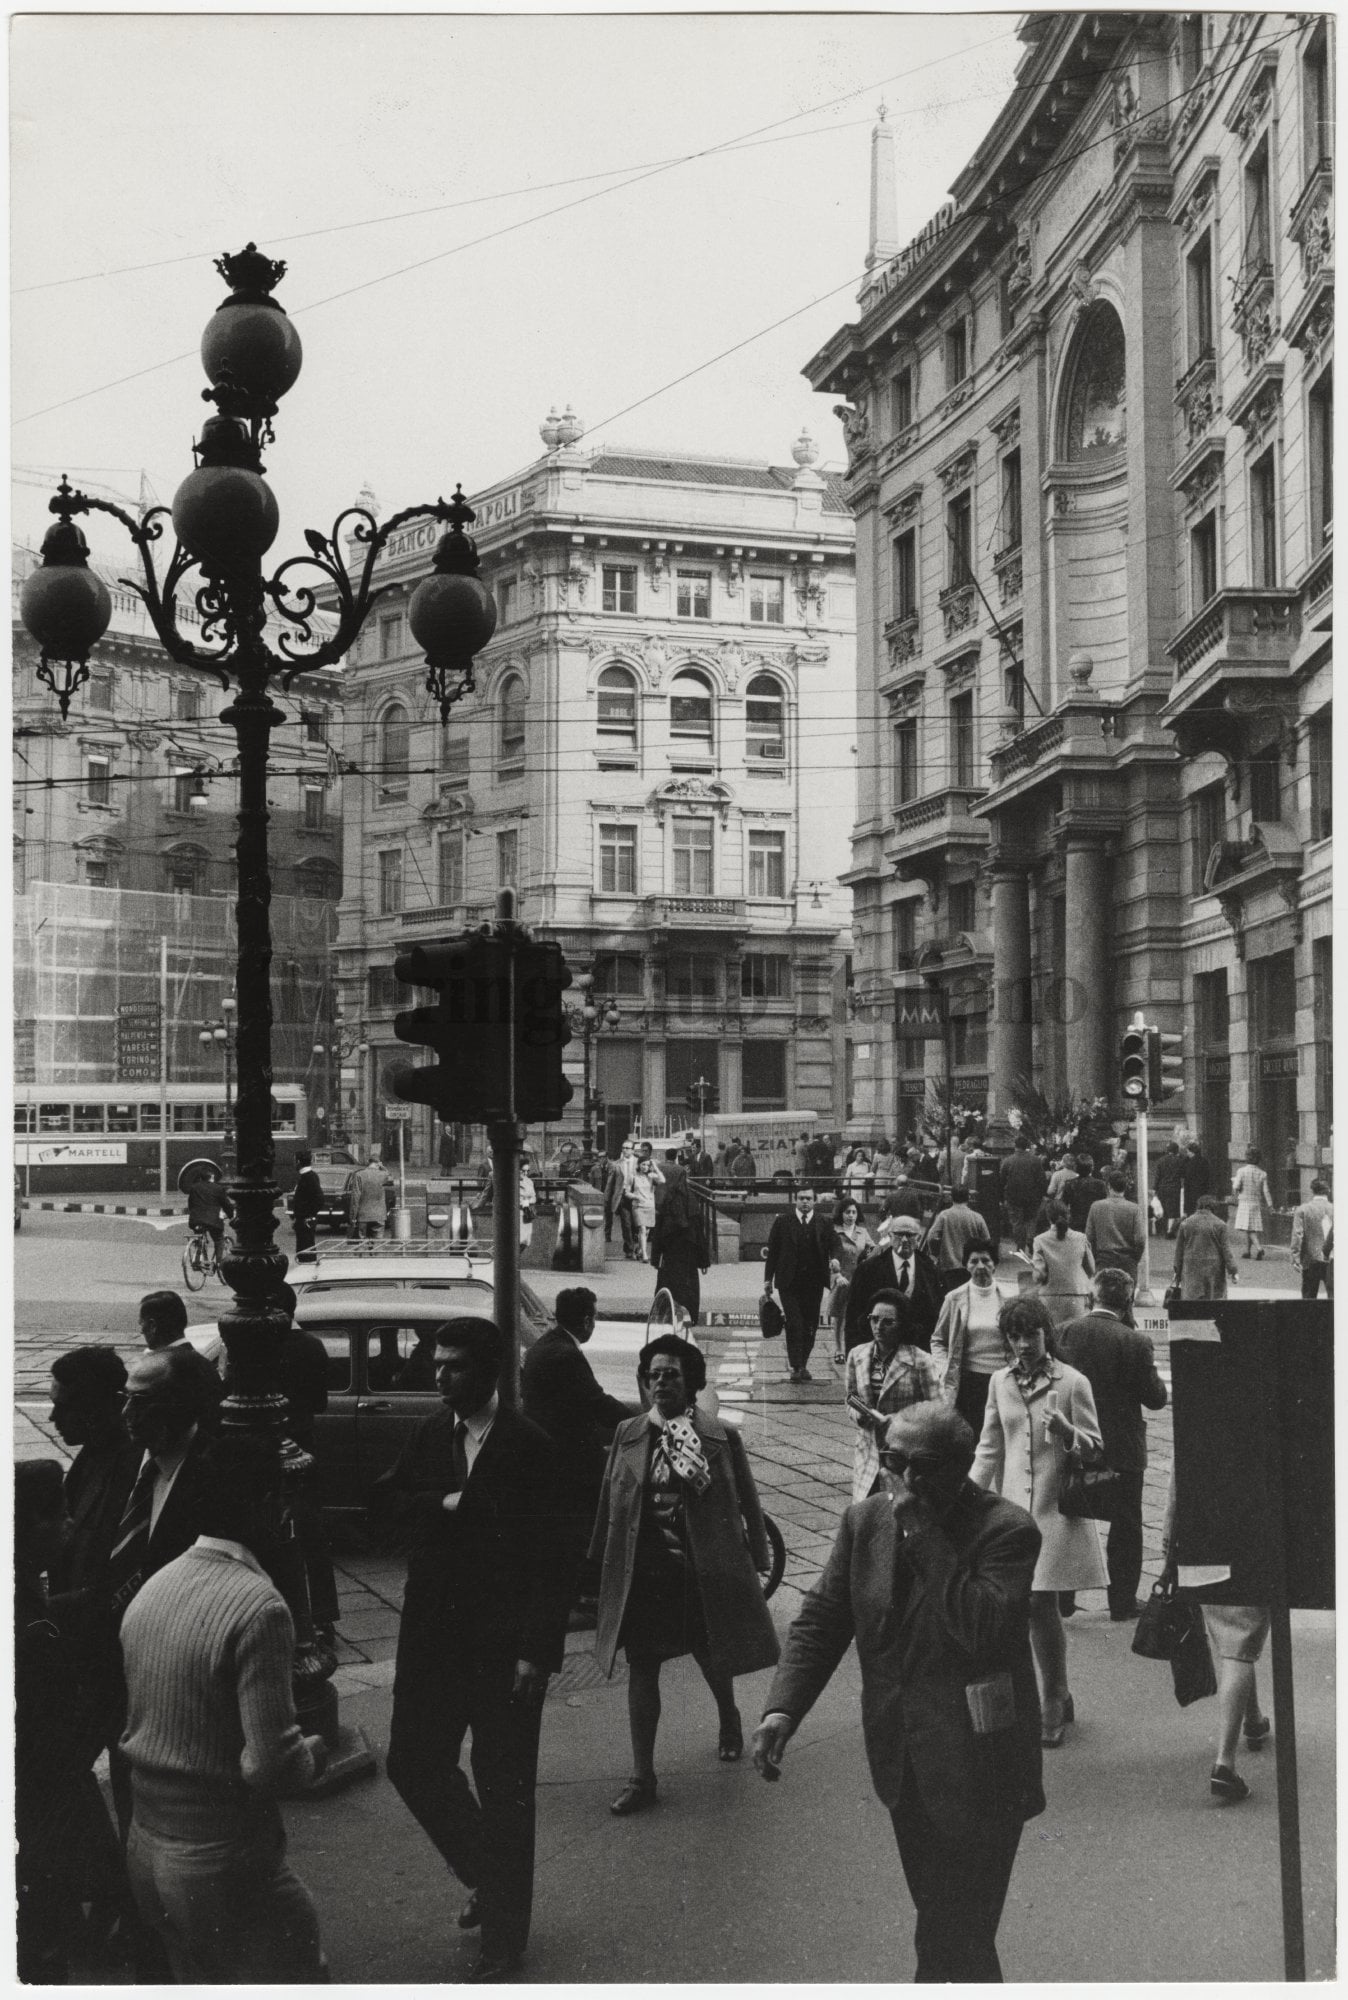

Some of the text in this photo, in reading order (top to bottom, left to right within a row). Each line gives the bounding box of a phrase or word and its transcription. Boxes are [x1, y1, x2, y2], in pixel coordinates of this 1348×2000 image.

[388, 526, 437, 557] BANCO
[900, 1007, 940, 1024] MM
[121, 1043, 150, 1052] VARESE
[121, 1055, 150, 1065] TORINO
[122, 1068, 149, 1077] COMO
[68, 1149, 121, 1157] MARTELL
